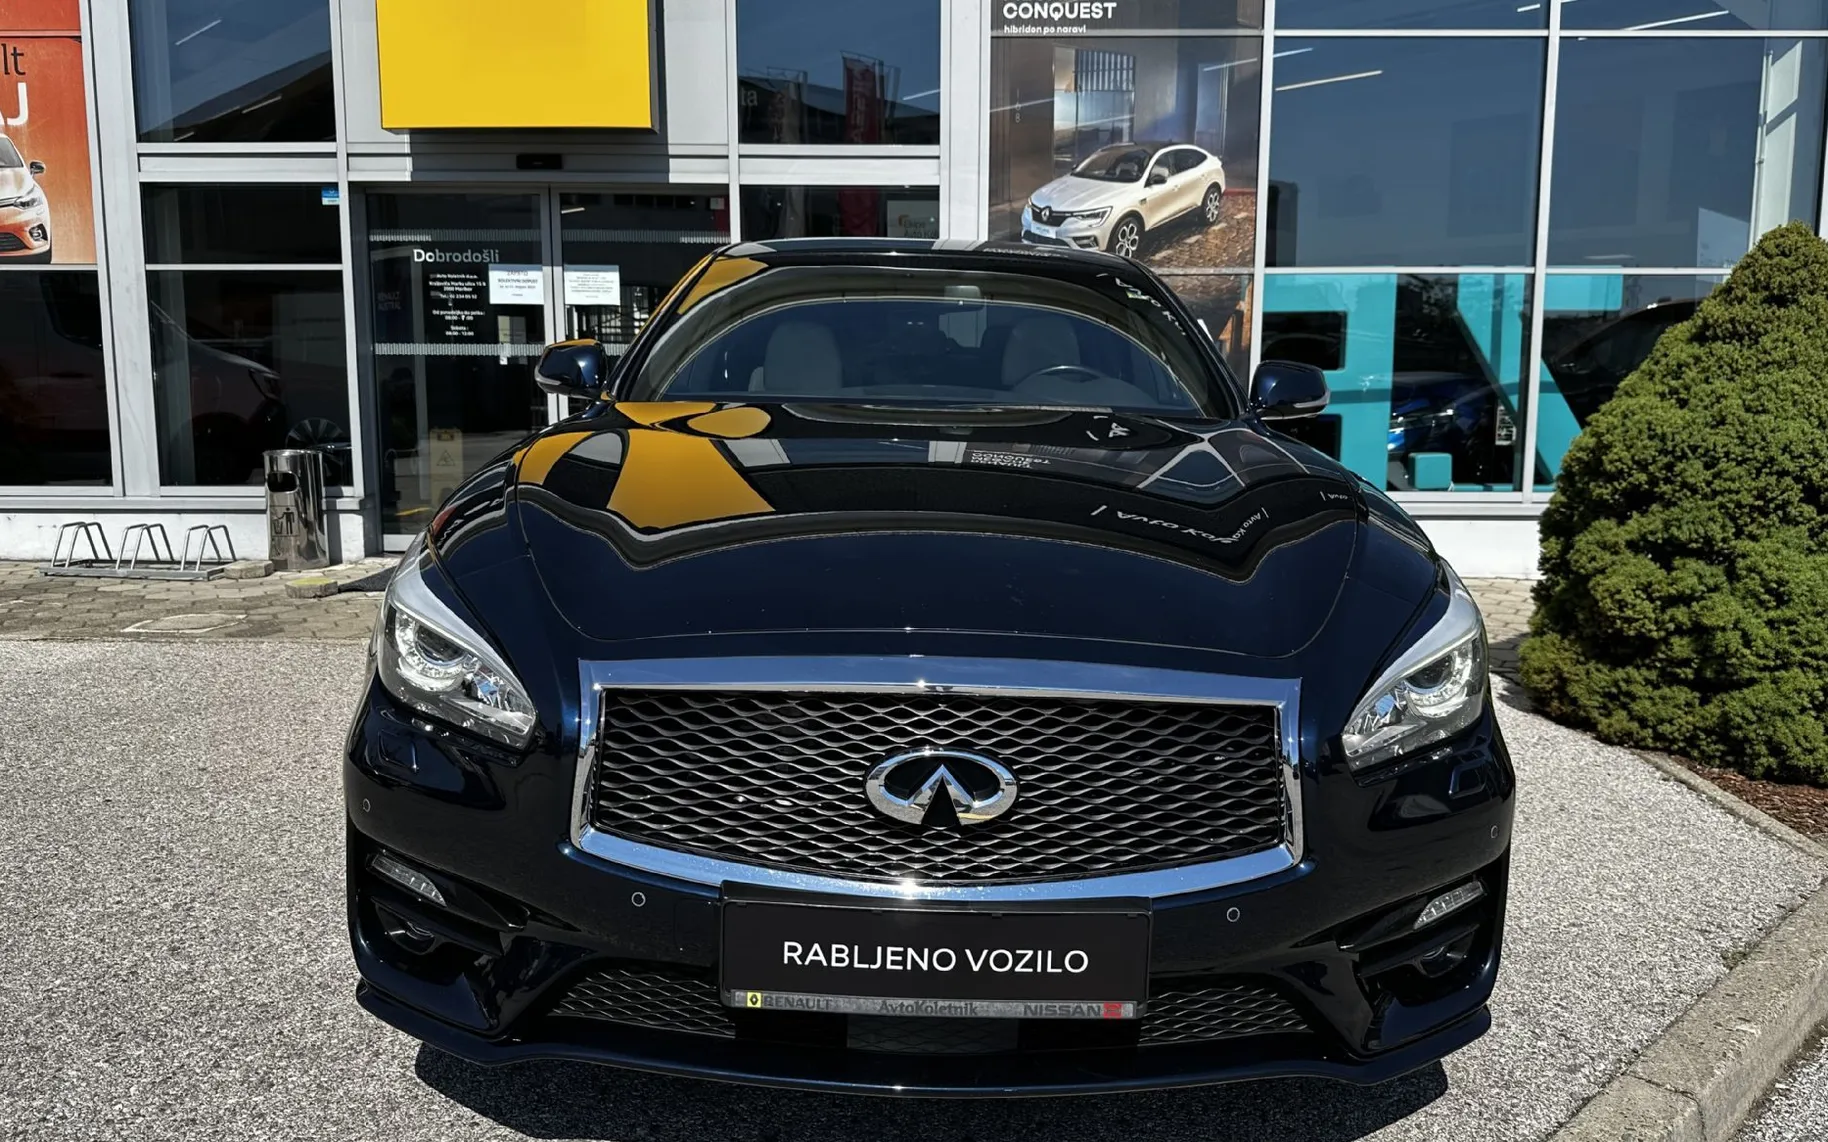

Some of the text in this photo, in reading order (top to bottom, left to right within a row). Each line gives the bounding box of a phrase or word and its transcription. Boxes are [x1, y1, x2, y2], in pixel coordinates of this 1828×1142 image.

[1003, 2, 1117, 20] CONQUEST
[413, 249, 499, 263] Dobrodošli
[782, 941, 1089, 974] RABLJENO VOZILO
[763, 994, 1101, 1018] RENAULT AvtoKoletnik NISSAN
